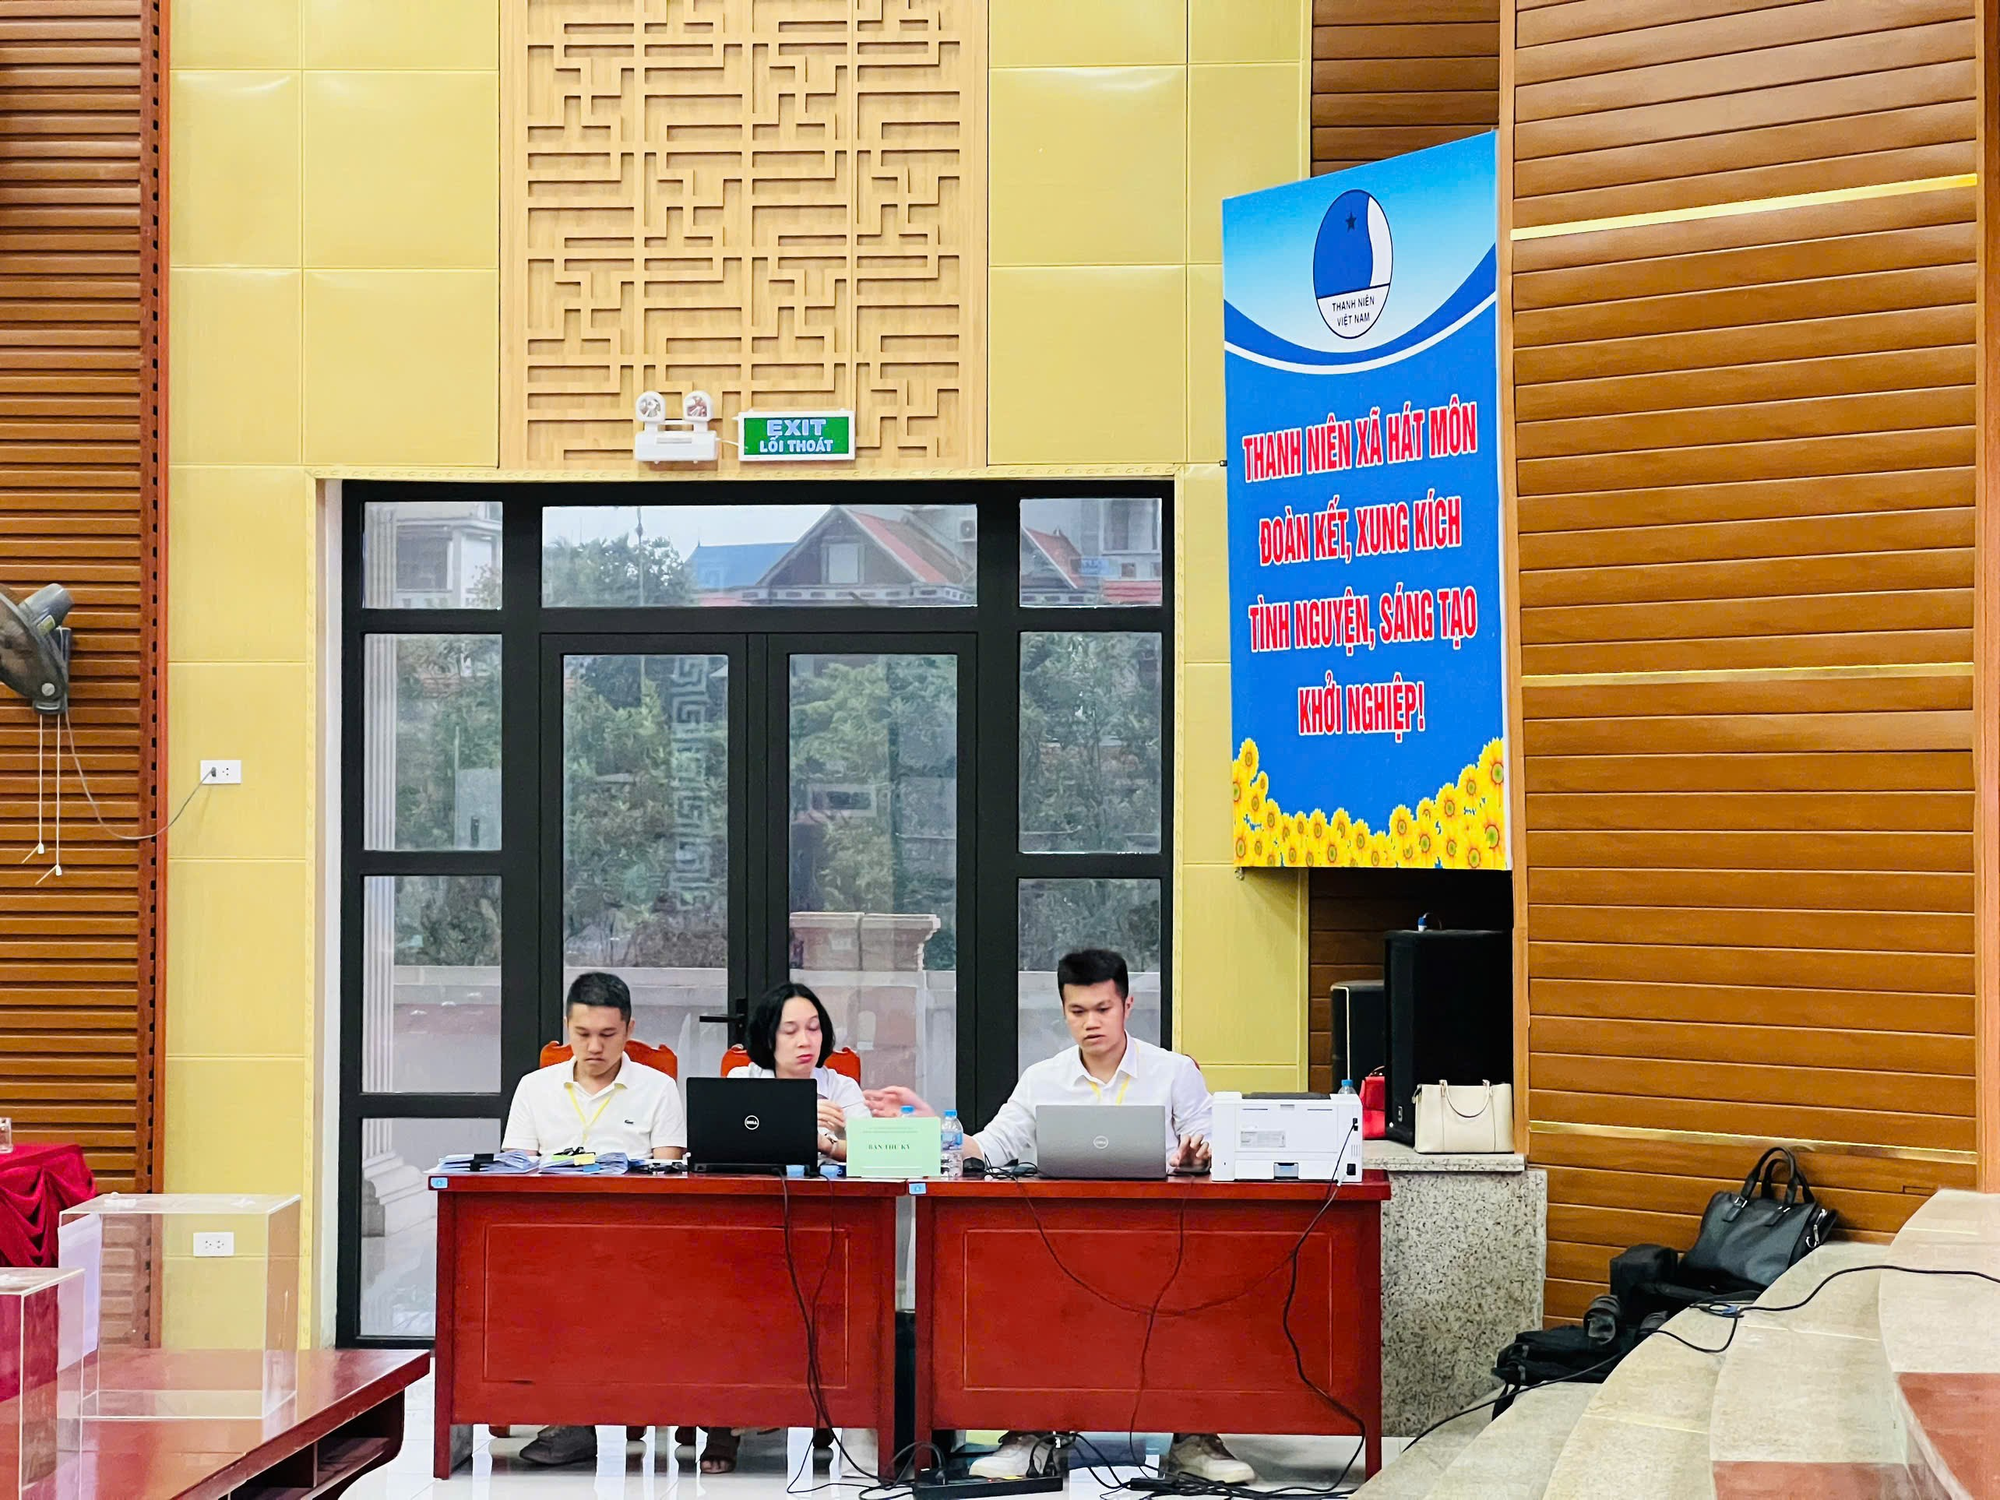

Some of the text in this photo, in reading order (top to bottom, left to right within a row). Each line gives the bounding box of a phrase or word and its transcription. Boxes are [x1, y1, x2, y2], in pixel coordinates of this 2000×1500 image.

[1332, 295, 1375, 312] THANH NIÊN
[1337, 312, 1371, 327] VIỆT NAM
[760, 436, 833, 453] LỐI THOÁT
[767, 419, 827, 436] EXIT
[1242, 393, 1478, 483] THANH NIÊN XÃ HÁT MÔN
[1259, 488, 1462, 566] ĐOÀN KẾT, XUNG KÍCH
[1248, 582, 1478, 656] TÌNH NGUYỆN, SÁNG TẠO
[1298, 670, 1426, 743] KHỞI NGHIỆP!
